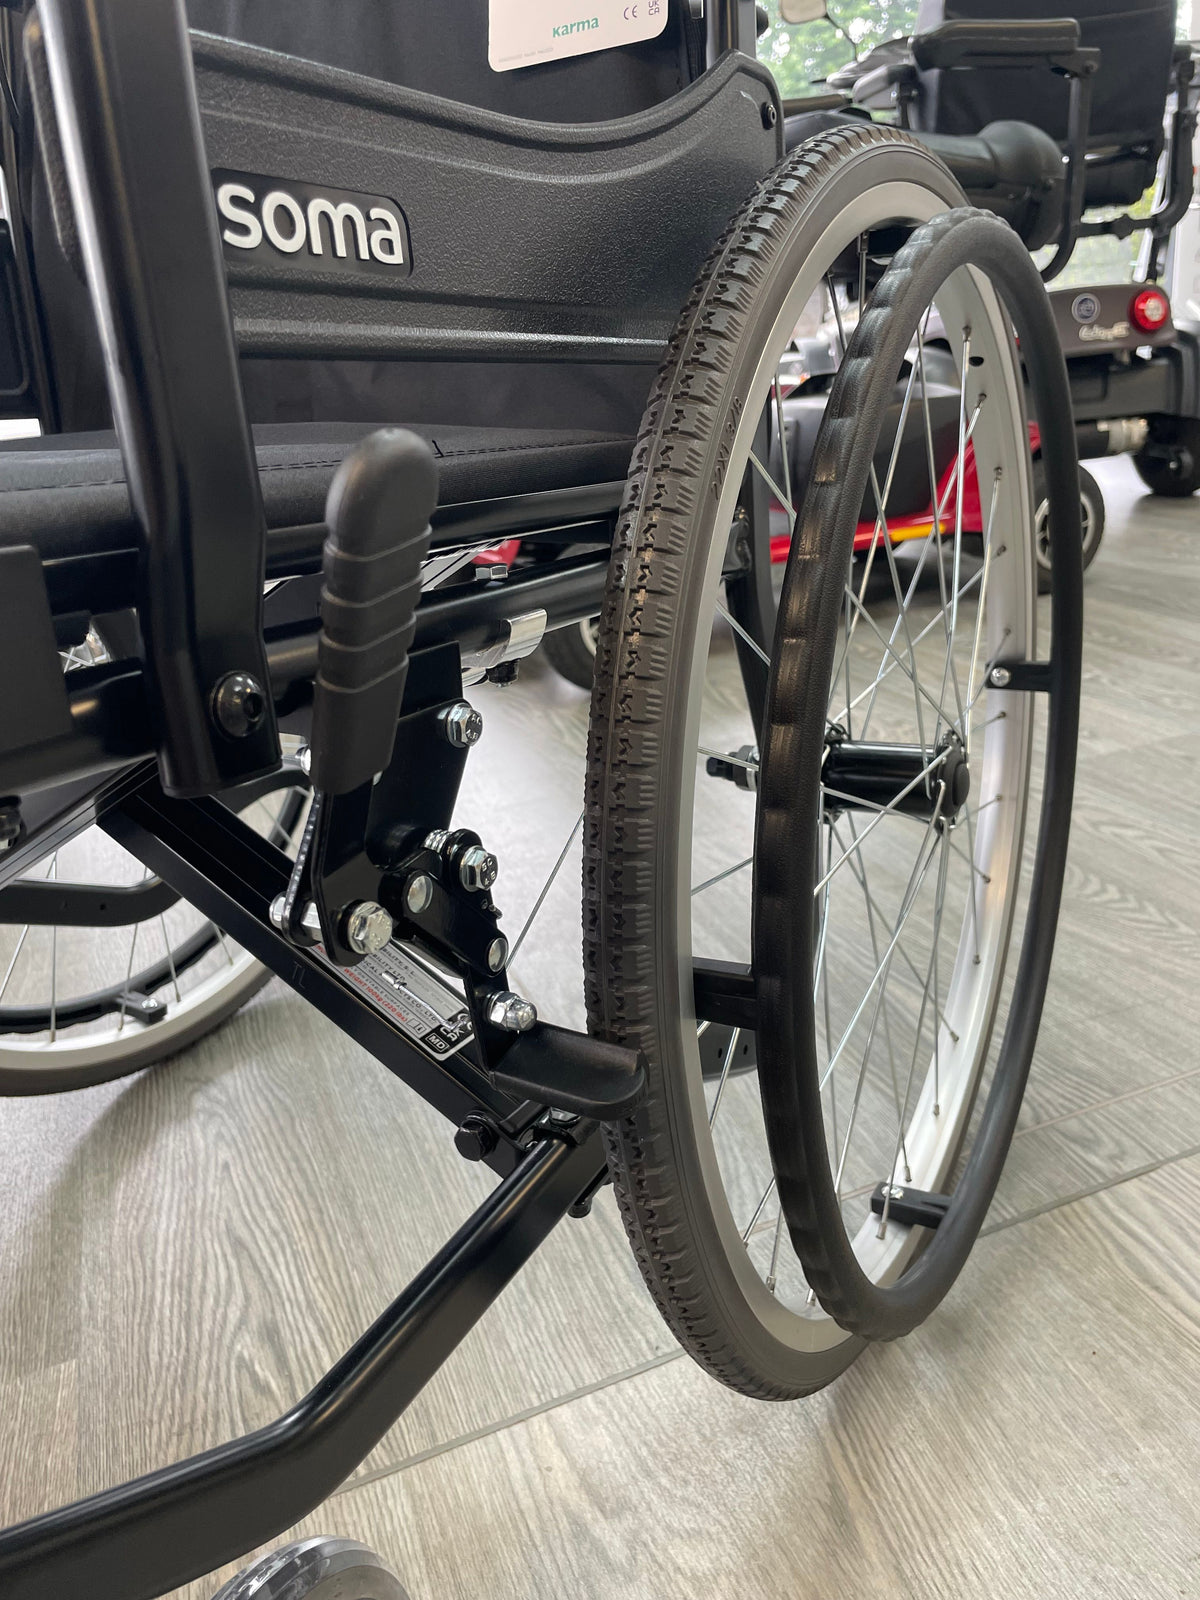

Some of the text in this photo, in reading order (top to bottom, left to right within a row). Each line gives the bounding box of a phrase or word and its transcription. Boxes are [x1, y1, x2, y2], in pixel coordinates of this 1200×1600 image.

[217, 183, 404, 265] soma
[343, 967, 368, 988] WEIGHT
[428, 1035, 446, 1049] MD
